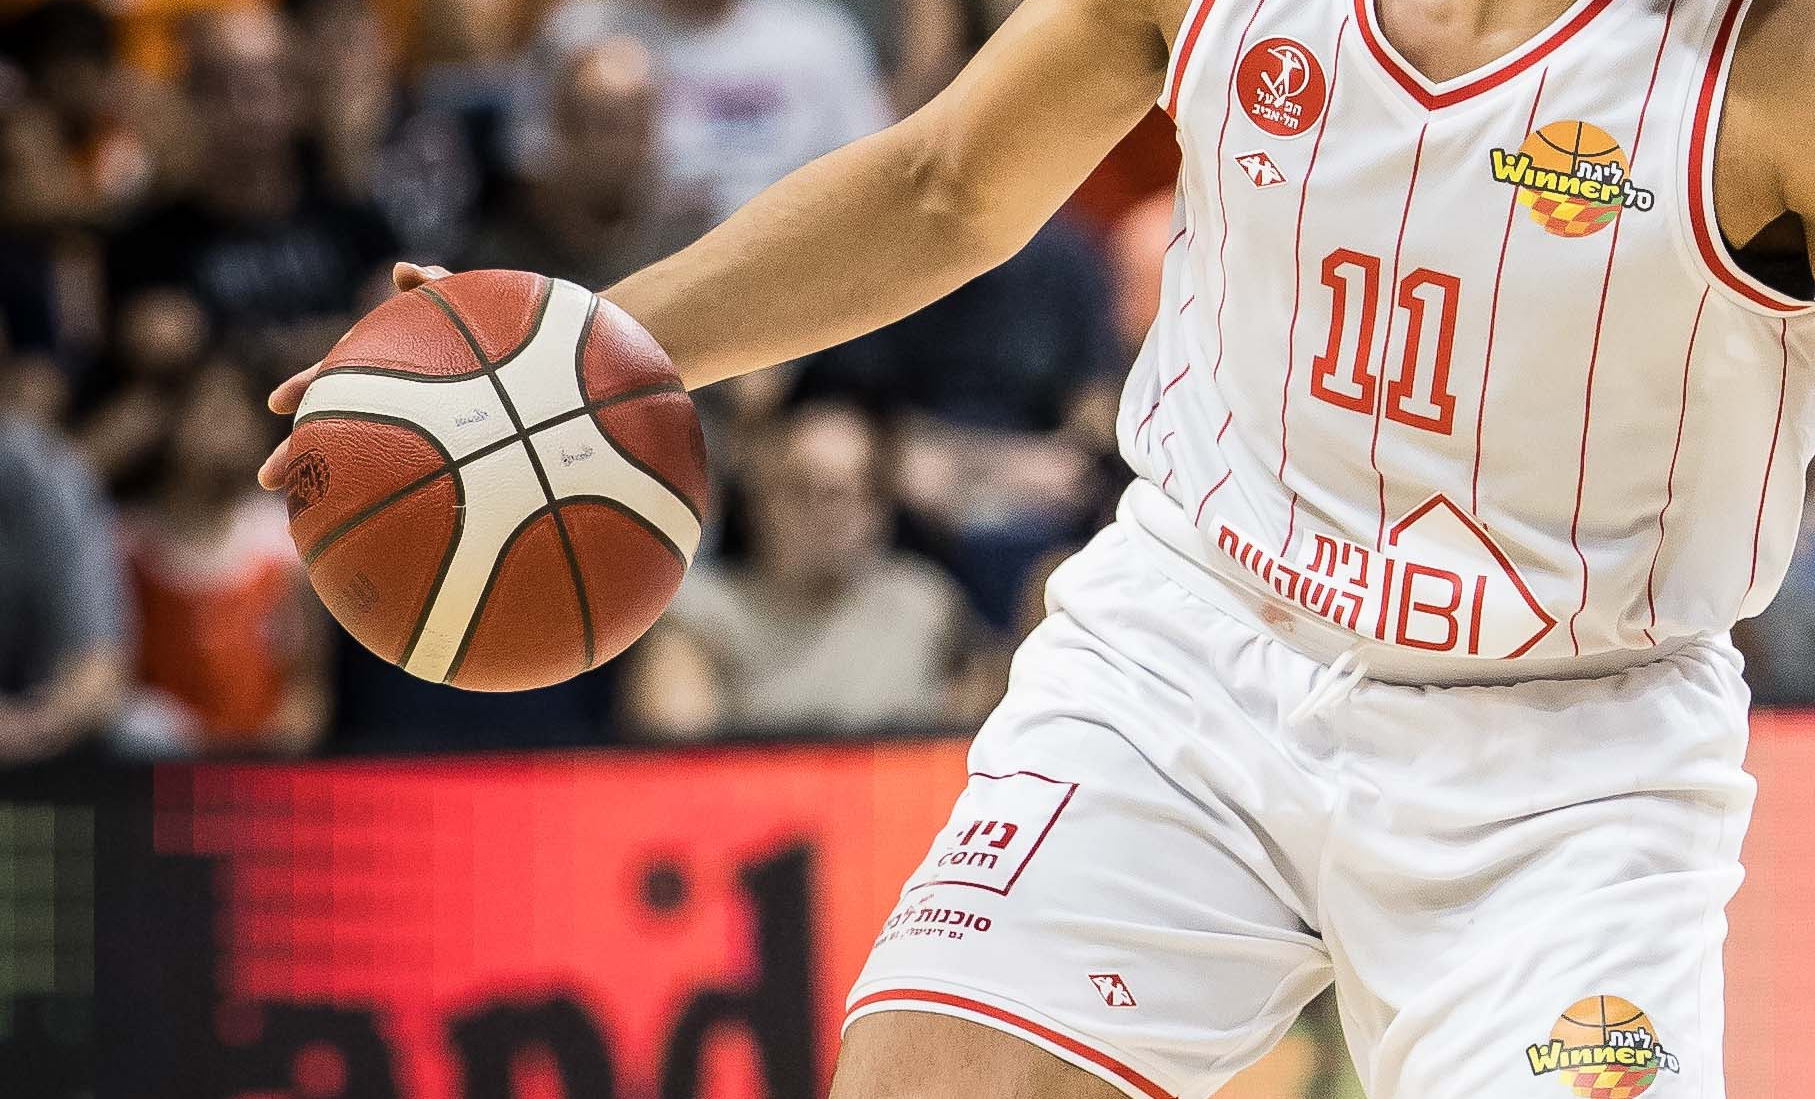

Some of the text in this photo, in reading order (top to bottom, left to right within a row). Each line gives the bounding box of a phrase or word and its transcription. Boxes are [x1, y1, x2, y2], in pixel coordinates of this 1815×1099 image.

[1490, 149, 1621, 203] Winner
[1578, 161, 1623, 184] ליגת
[1623, 180, 1654, 211] סל
[1310, 246, 1462, 436] 11
[1307, 534, 1369, 588] בית
[1375, 558, 1488, 656] IBI
[1527, 1039, 1652, 1075] Winner
[1609, 1028, 1651, 1049] ליגת
